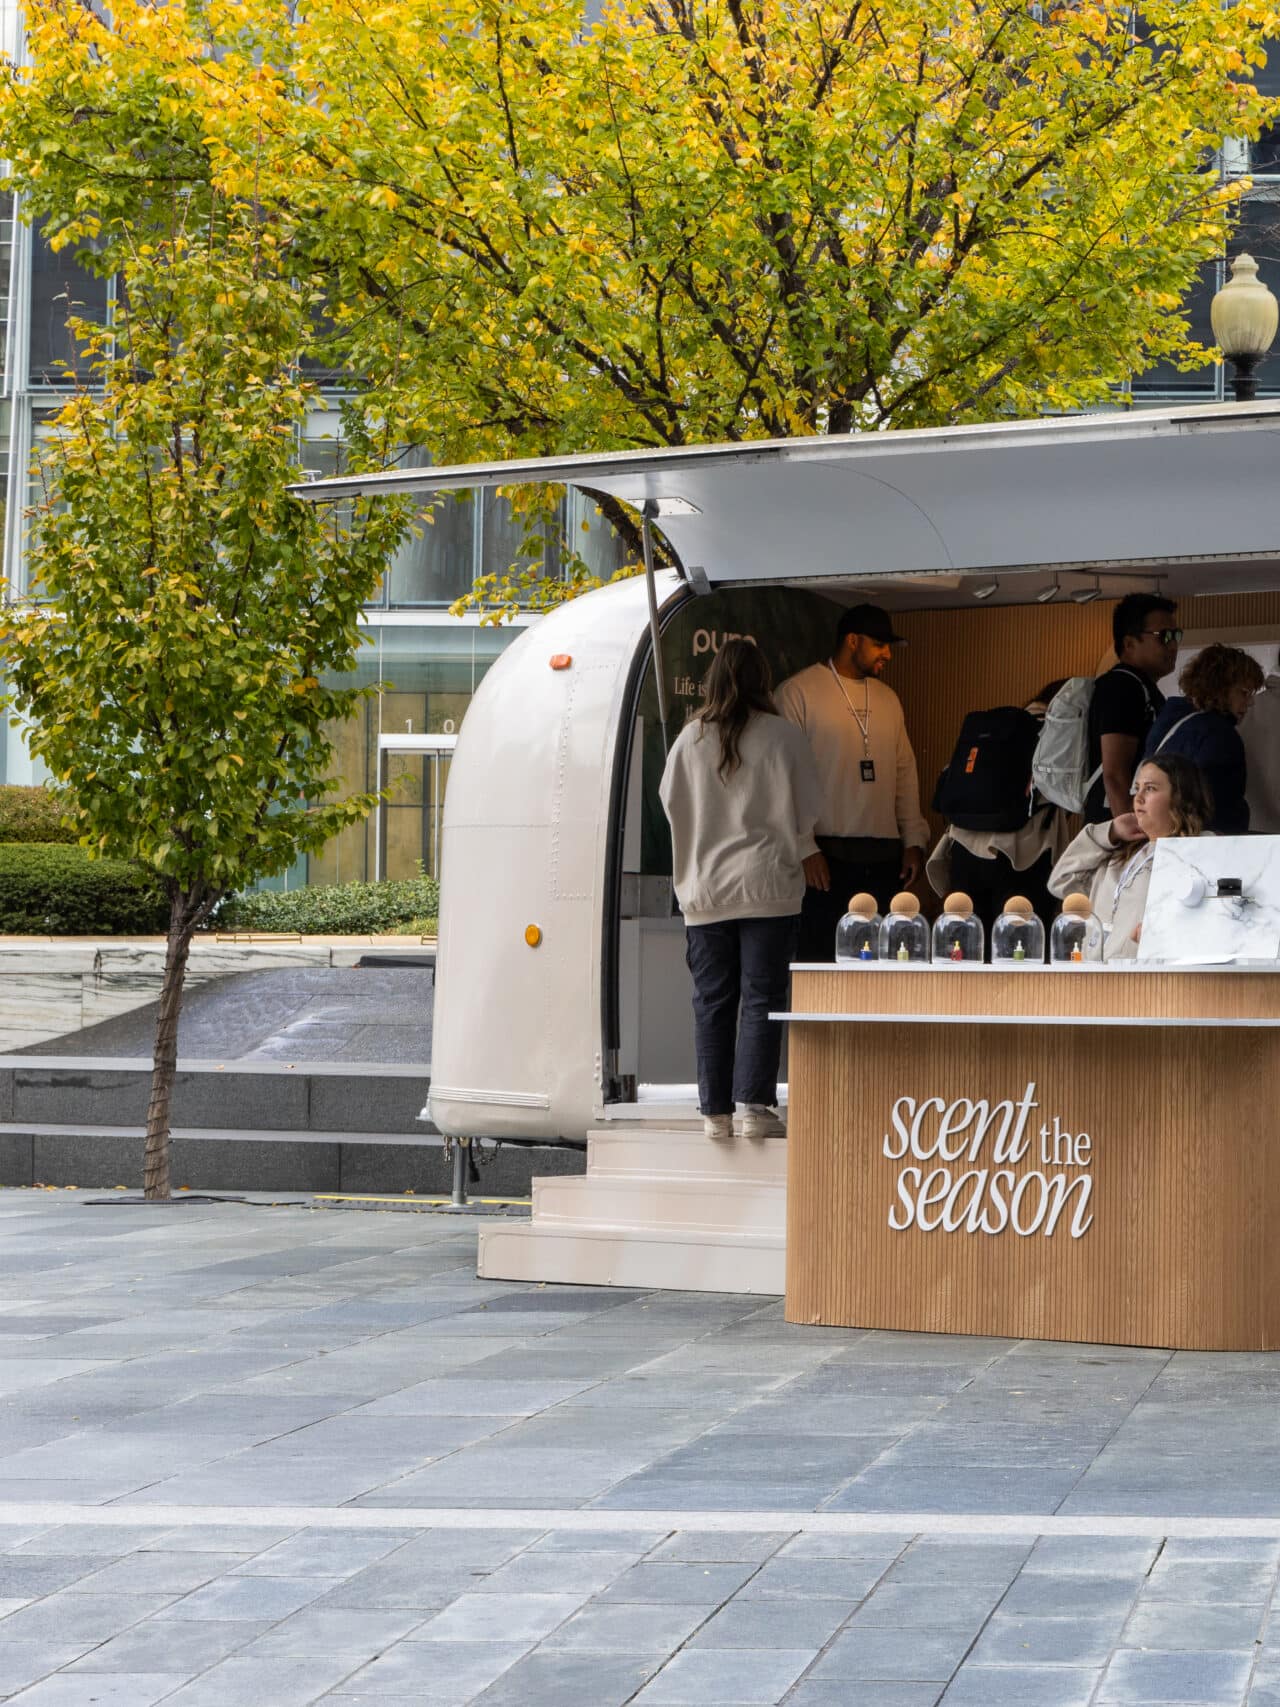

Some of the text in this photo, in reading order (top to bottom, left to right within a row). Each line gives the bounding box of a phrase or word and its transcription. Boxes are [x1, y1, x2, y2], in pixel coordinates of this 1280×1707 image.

[674, 675, 695, 696] Life
[883, 1082, 1093, 1166] scent the
[888, 1166, 1094, 1239] season
